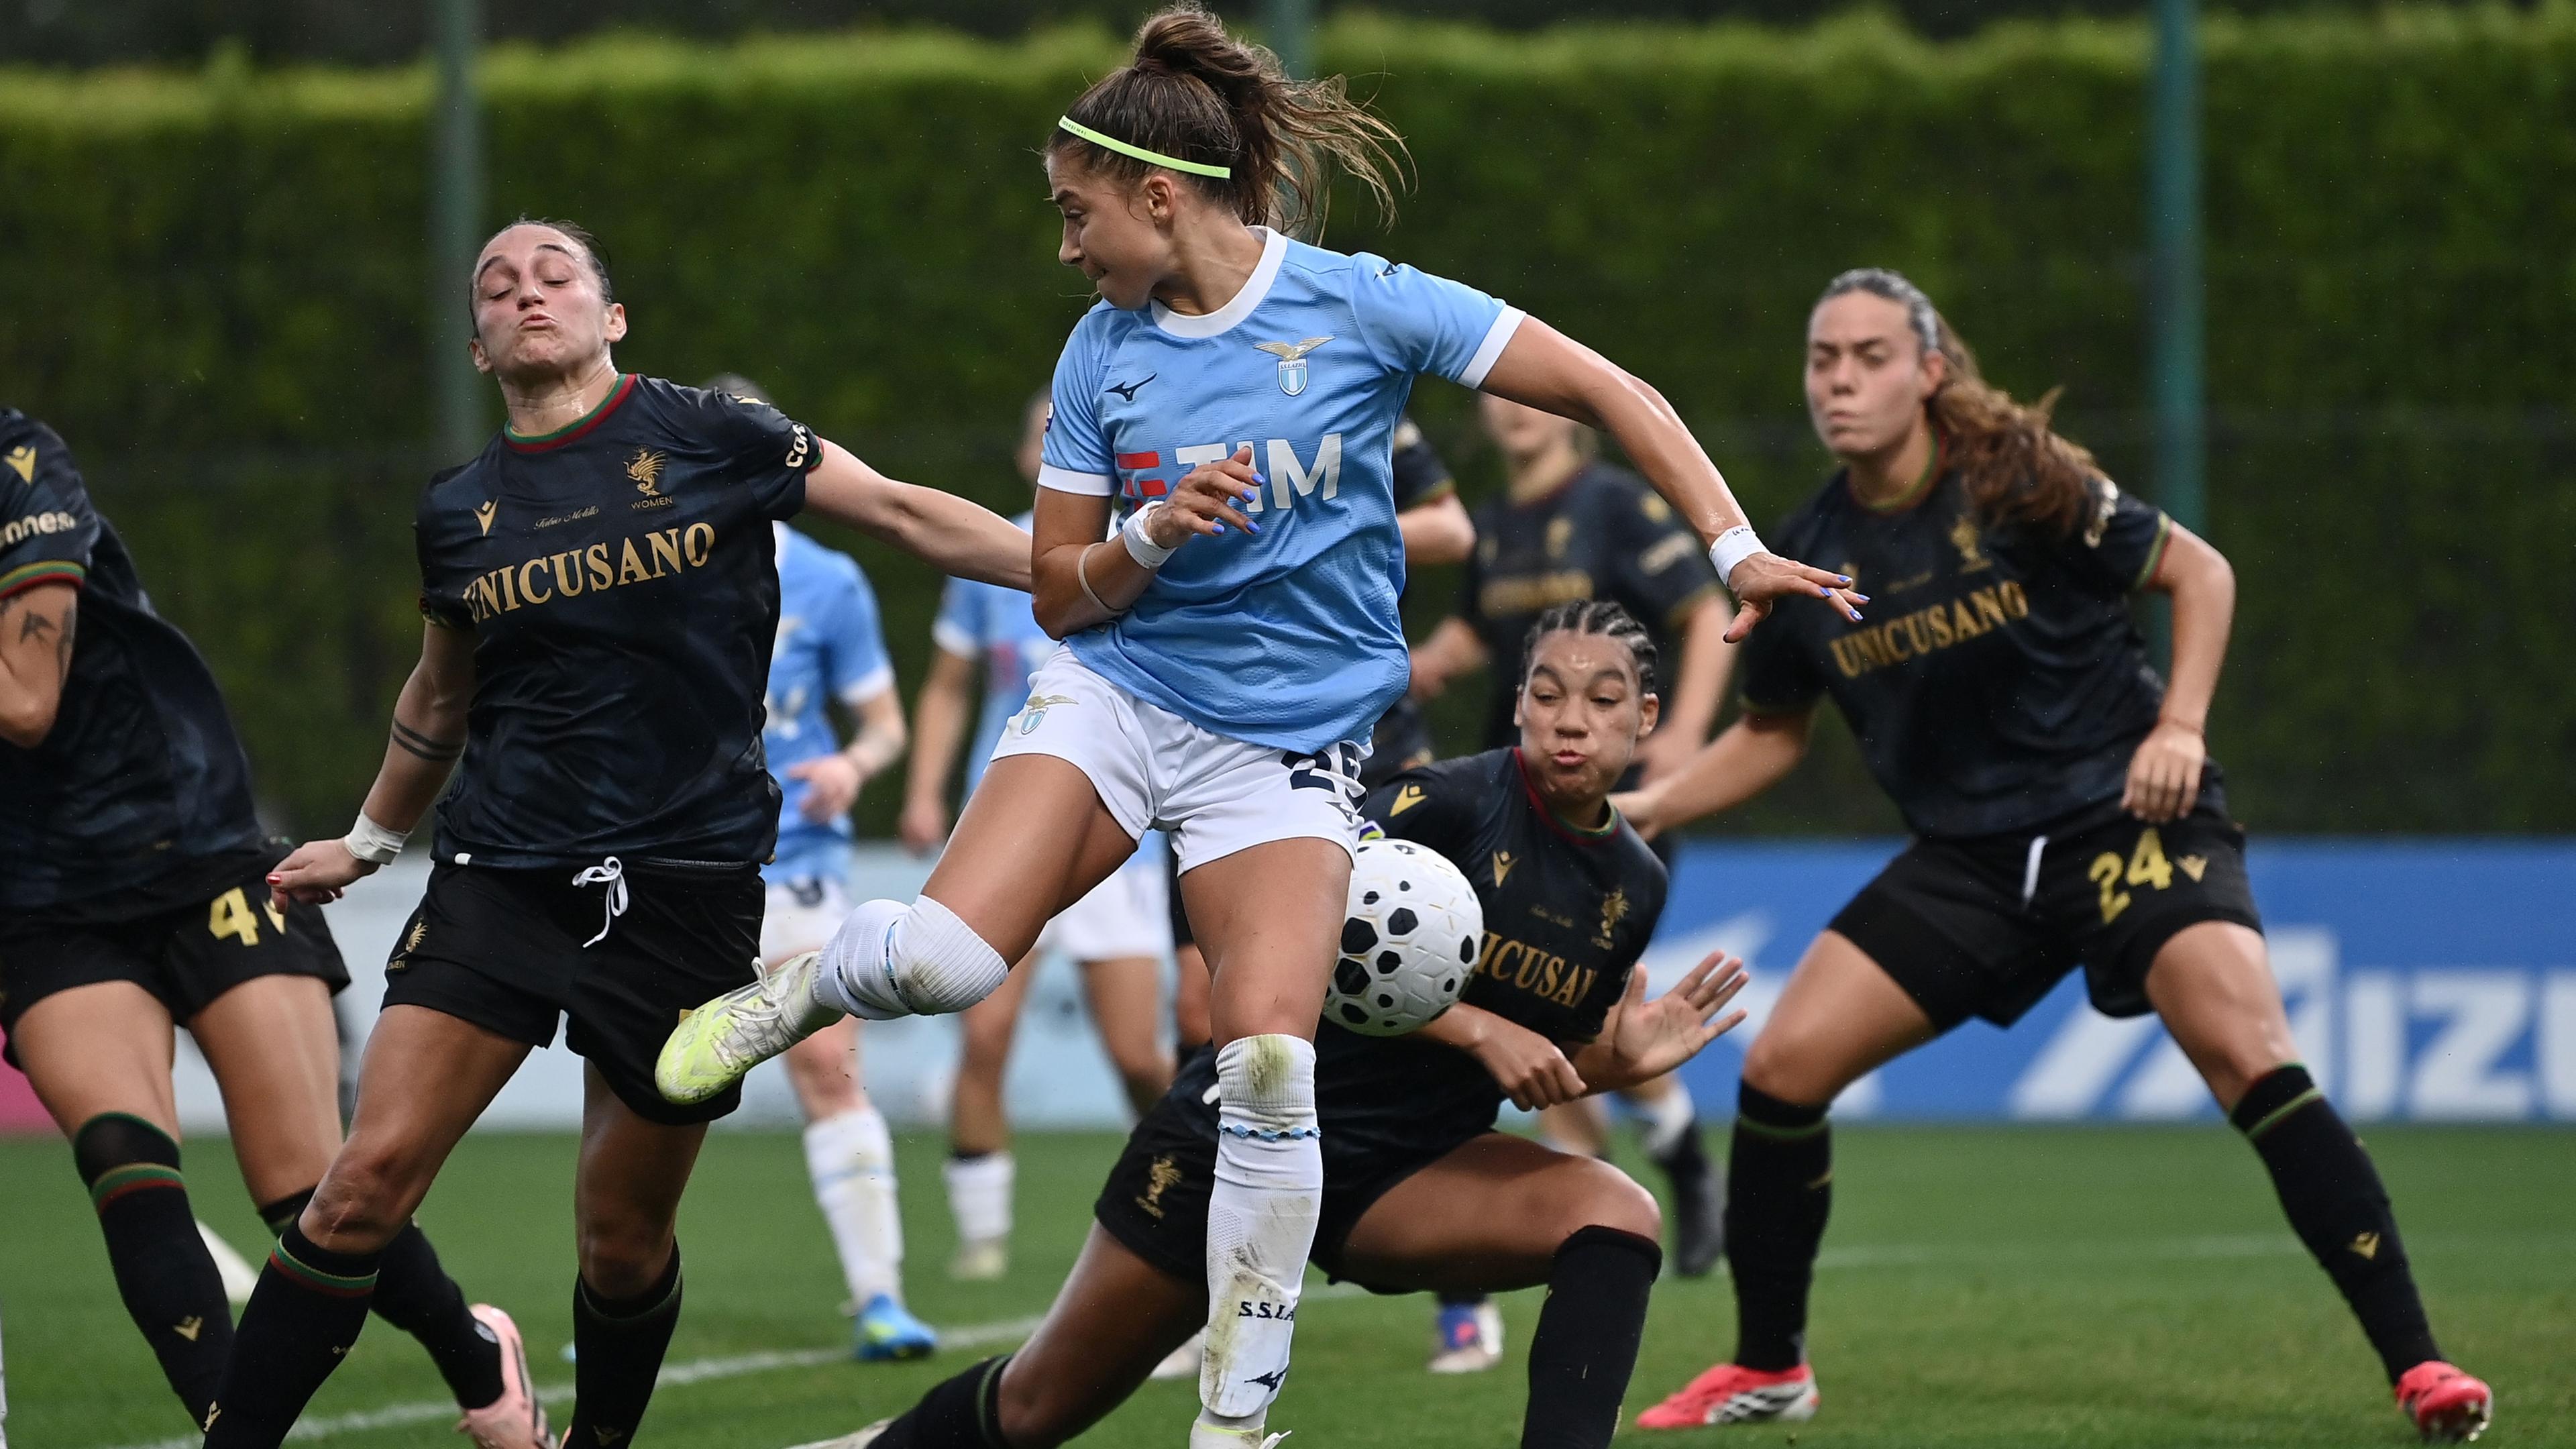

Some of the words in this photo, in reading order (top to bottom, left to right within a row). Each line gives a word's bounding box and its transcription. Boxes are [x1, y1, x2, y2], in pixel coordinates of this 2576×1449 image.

[631, 496, 674, 510] WOMEN
[1829, 580, 2029, 679] UNICUSANO
[2088, 826, 2174, 924] 24
[208, 885, 260, 947] 4
